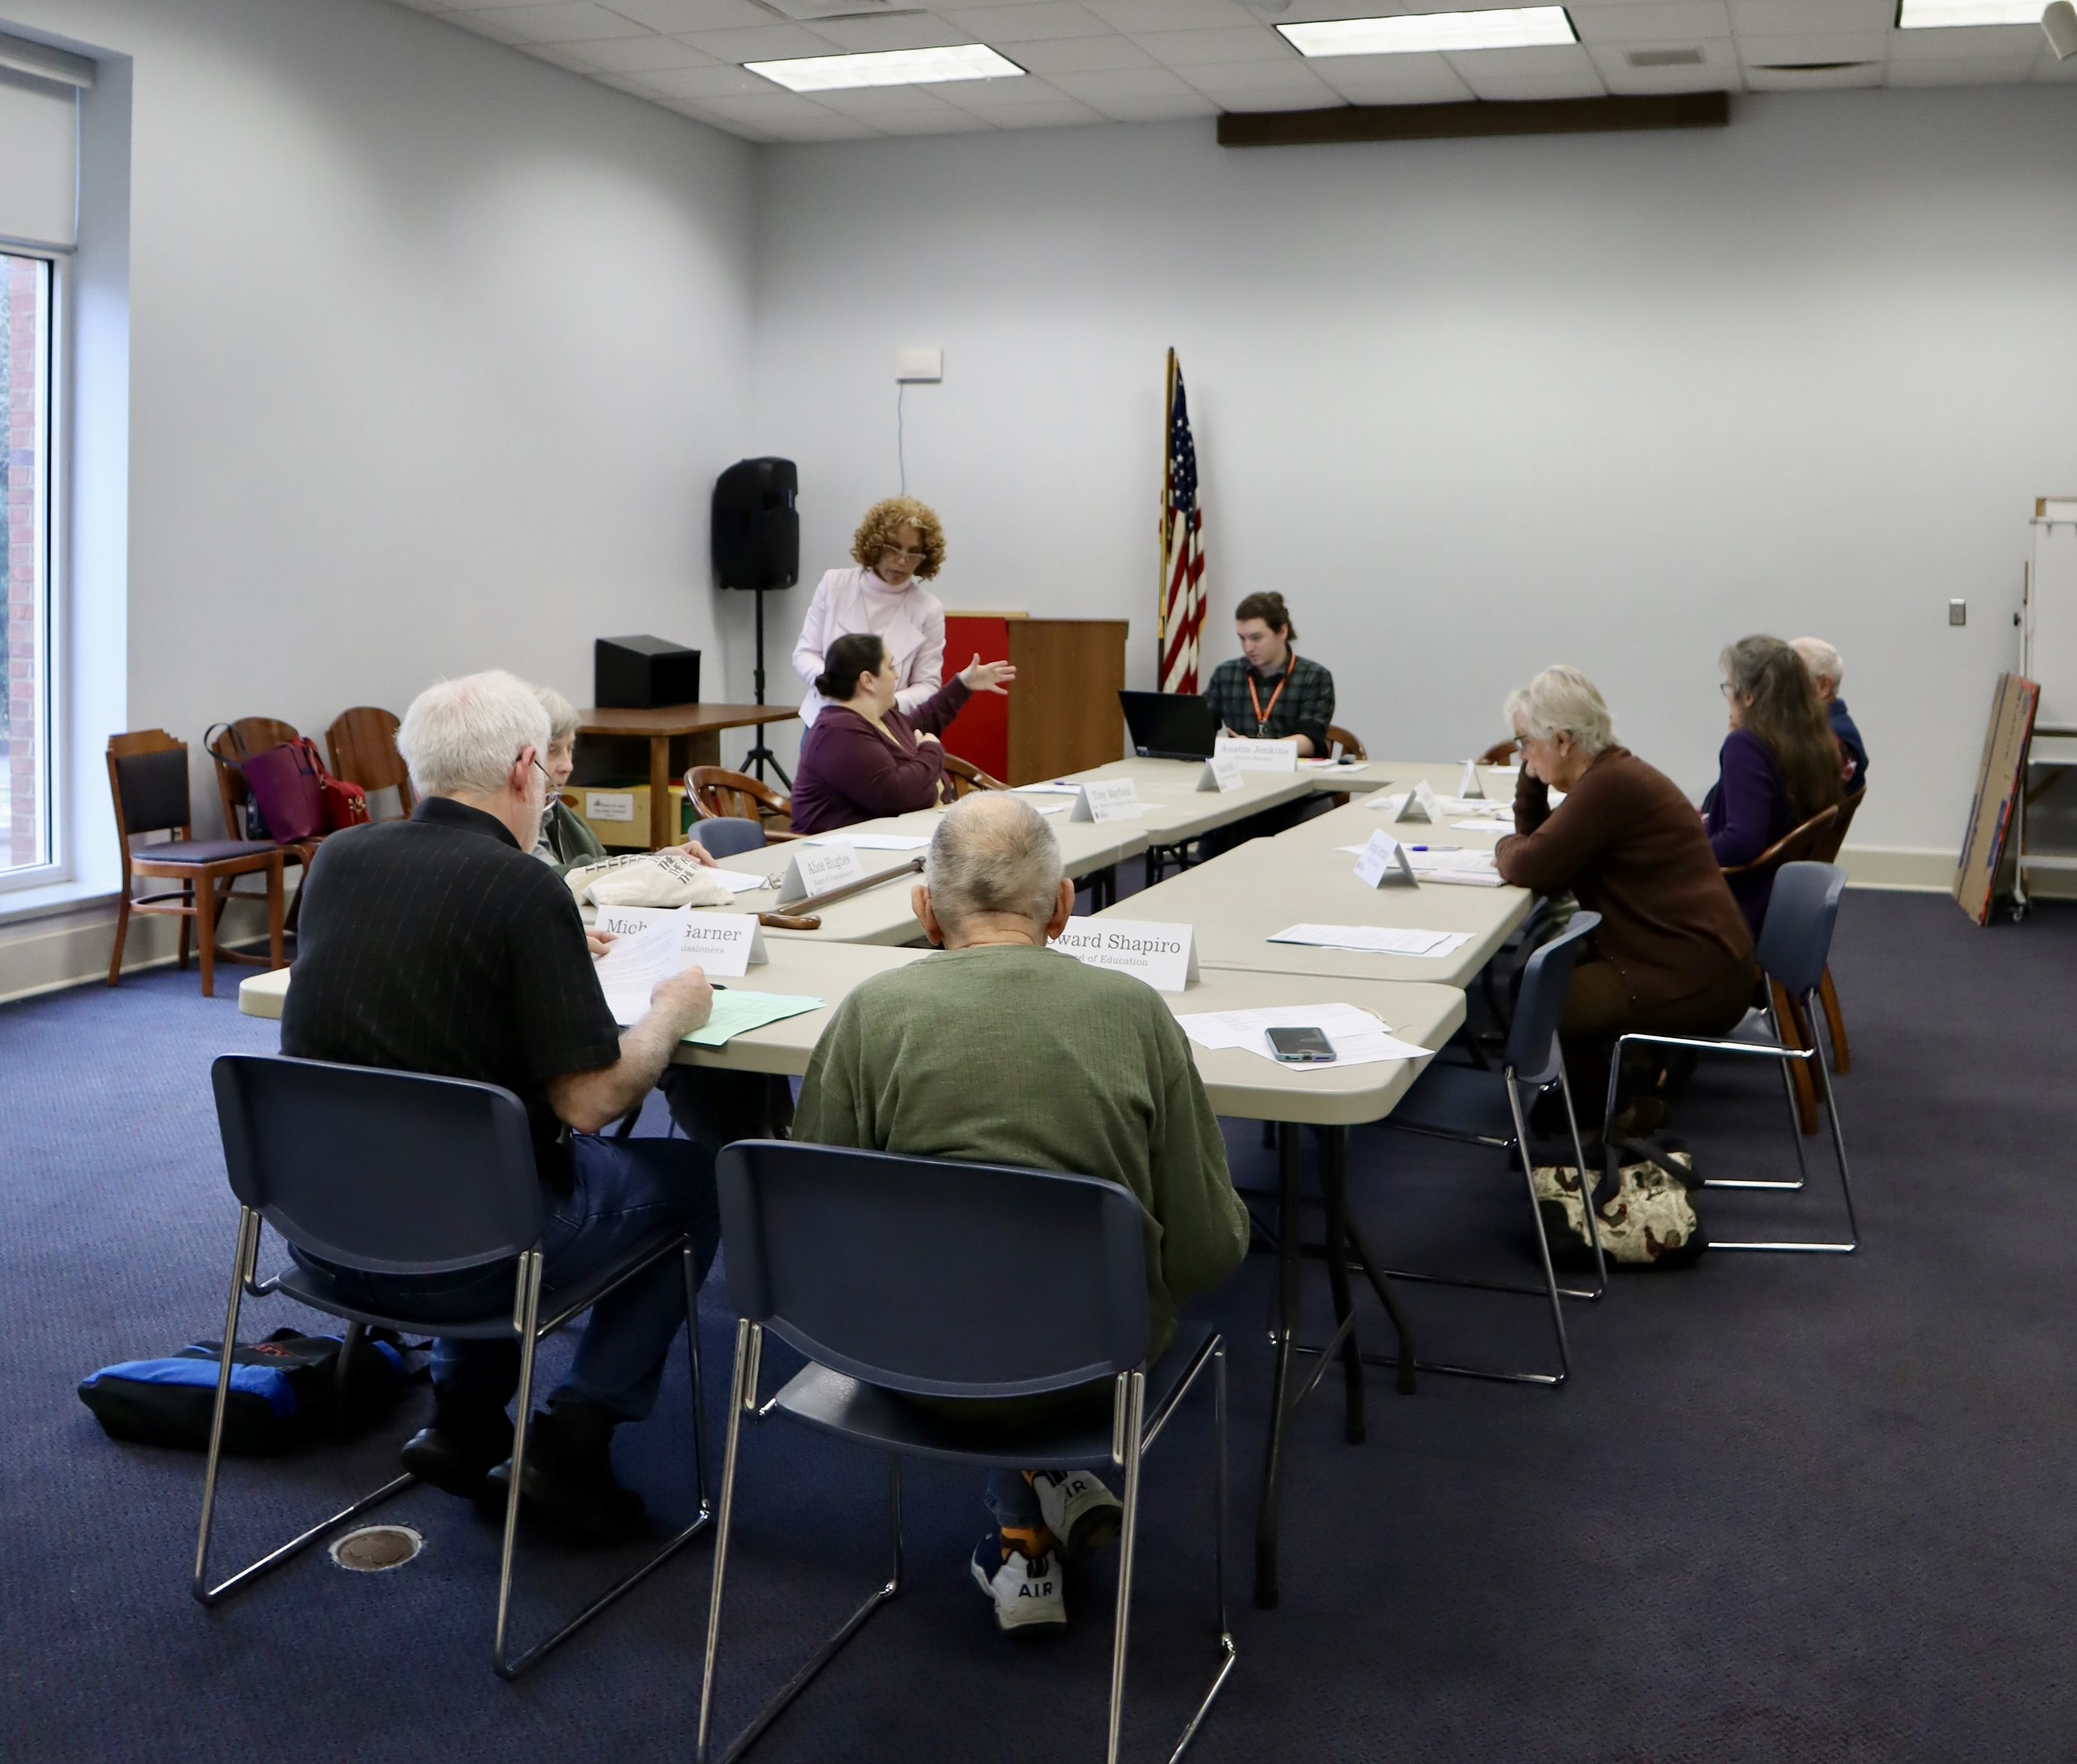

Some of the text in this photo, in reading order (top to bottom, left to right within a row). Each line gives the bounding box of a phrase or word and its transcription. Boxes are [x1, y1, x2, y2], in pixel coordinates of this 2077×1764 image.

[1221, 745, 1290, 755] Austin Jenkins
[808, 854, 851, 875] Alice Hughes
[607, 918, 647, 935] Mich
[1047, 933, 1180, 956] ward Shapiro
[1087, 954, 1098, 962] of
[1100, 955, 1148, 966] Education
[1065, 1480, 1087, 1499] IR
[1018, 1581, 1053, 1598] AIR
